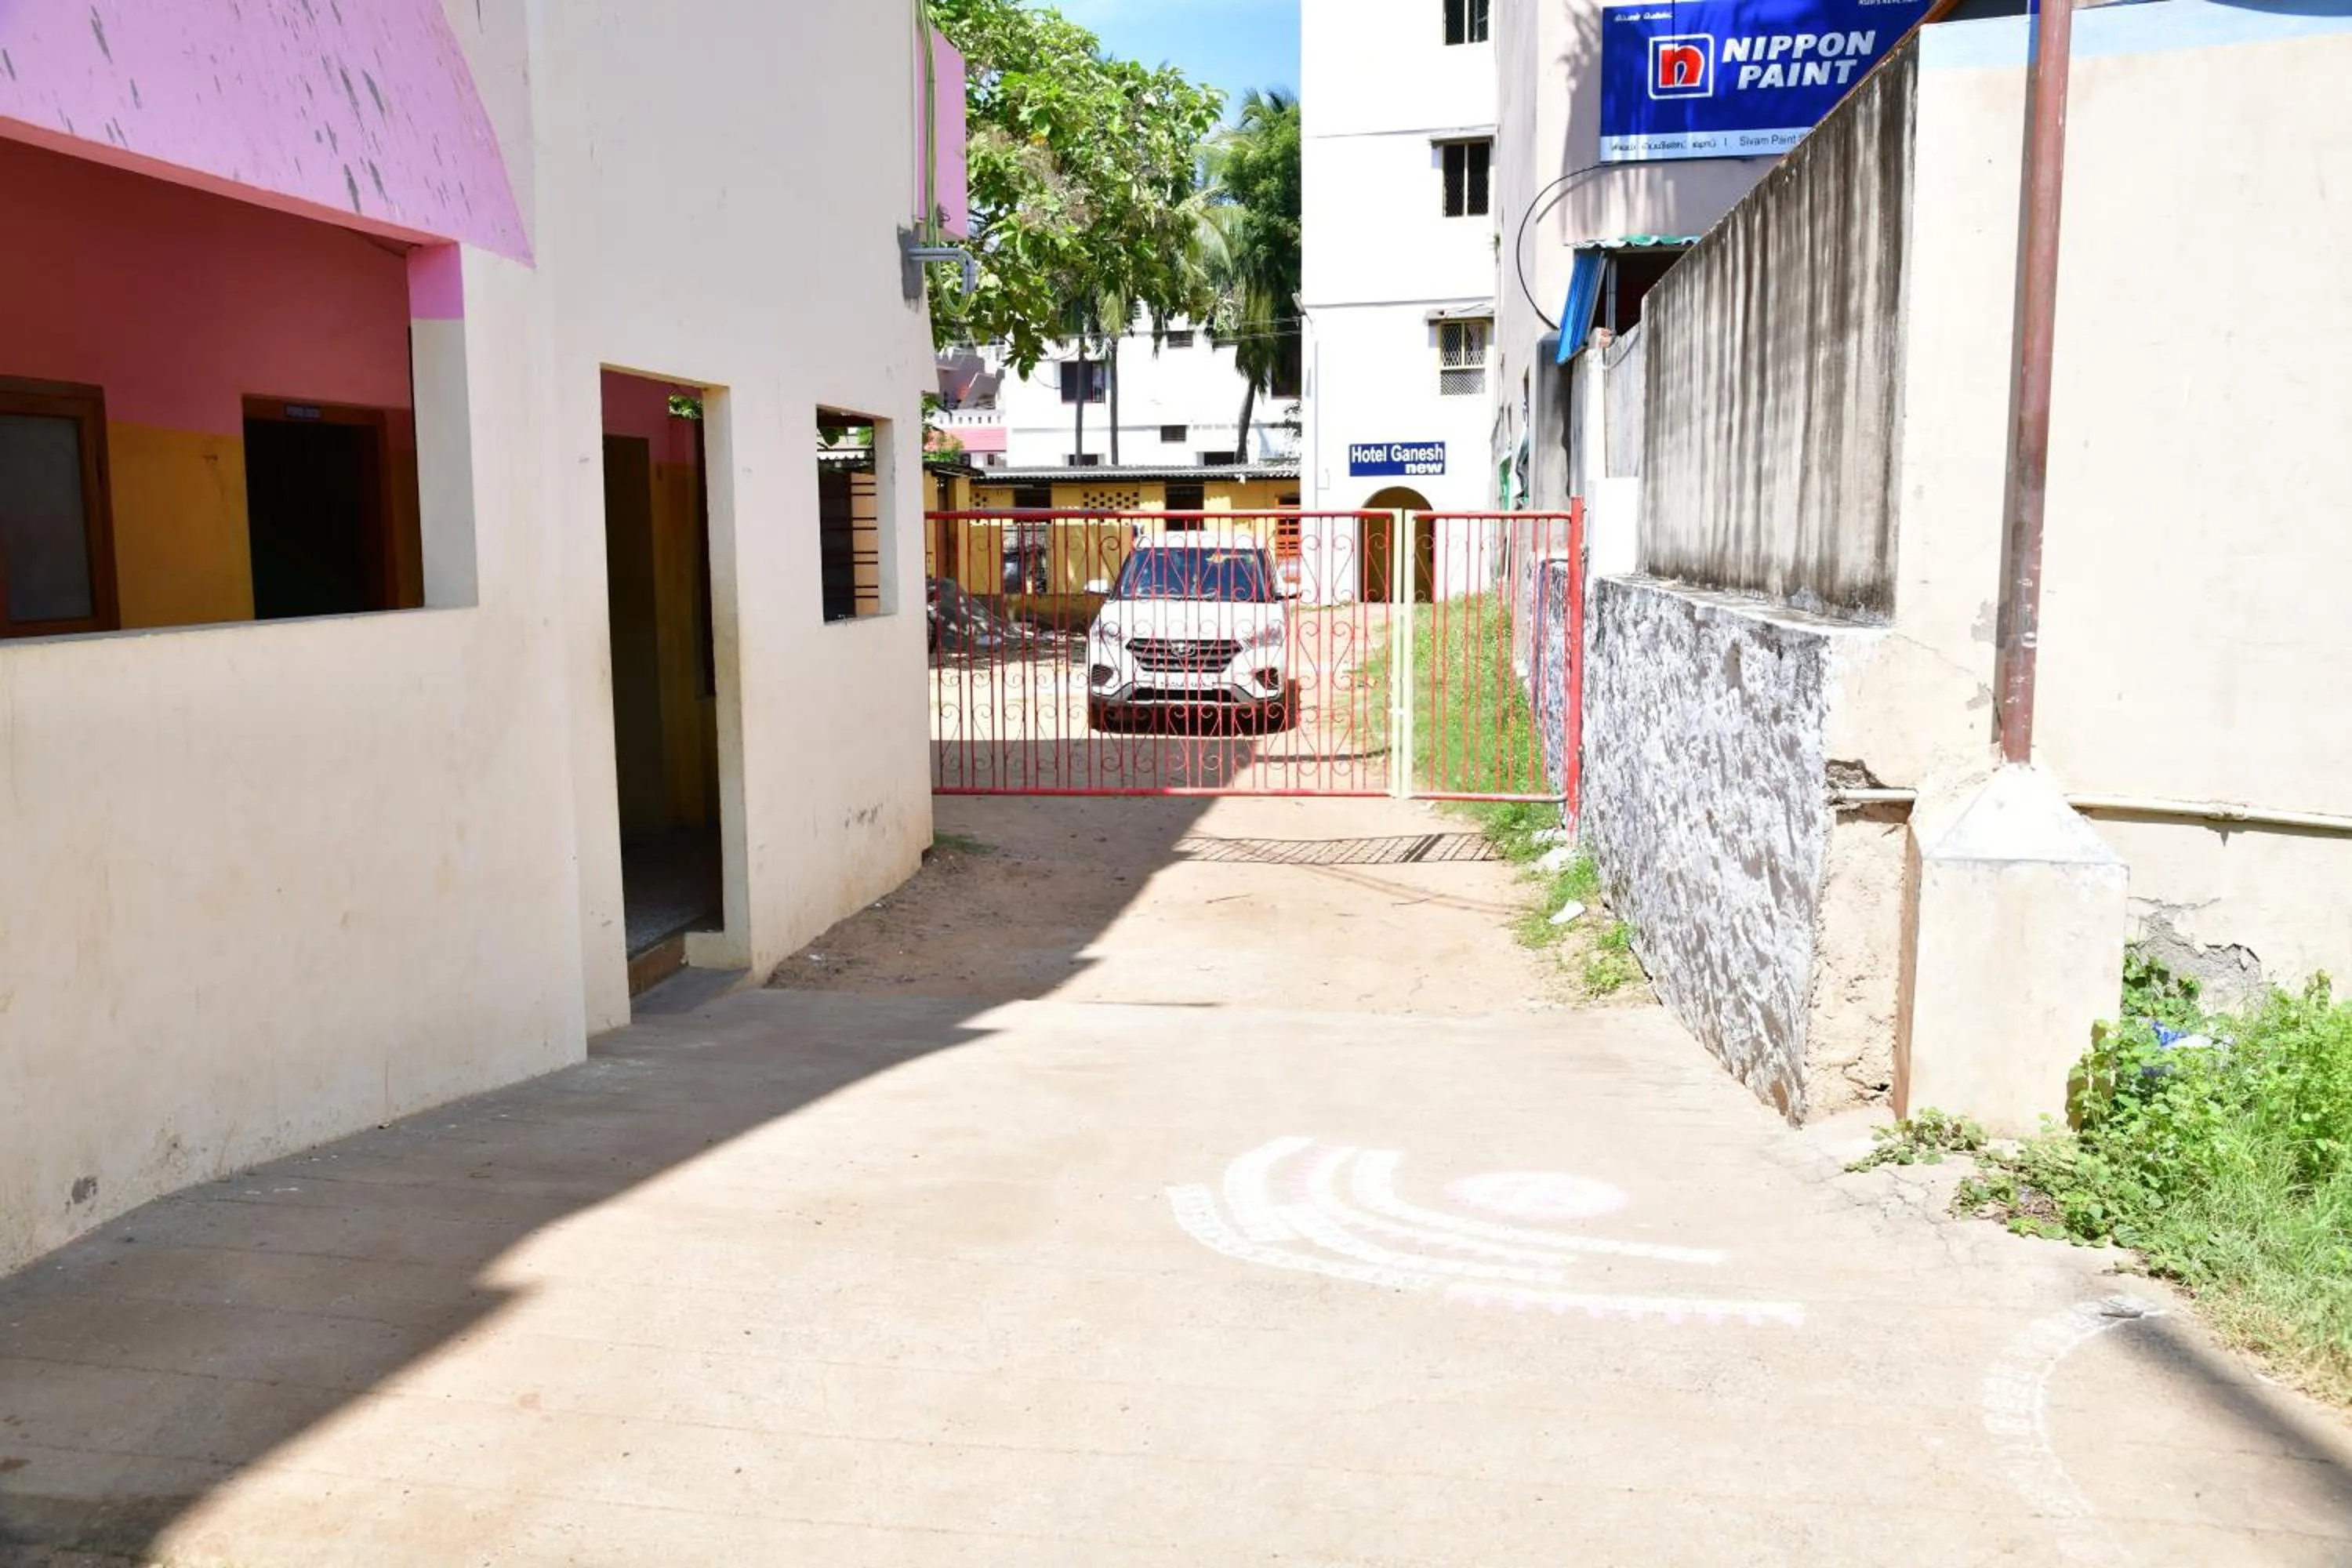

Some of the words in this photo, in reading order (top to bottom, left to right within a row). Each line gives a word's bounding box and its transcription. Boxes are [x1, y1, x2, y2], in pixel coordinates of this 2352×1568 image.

[1722, 30, 1876, 63] NIPPON
[1737, 59, 1857, 89] PAINT
[1739, 135, 1769, 147] Sivam
[1771, 133, 1797, 145] Paint
[1351, 445, 1387, 463] Hotel
[1391, 443, 1443, 462] Ganesh
[1405, 463, 1443, 474] new
